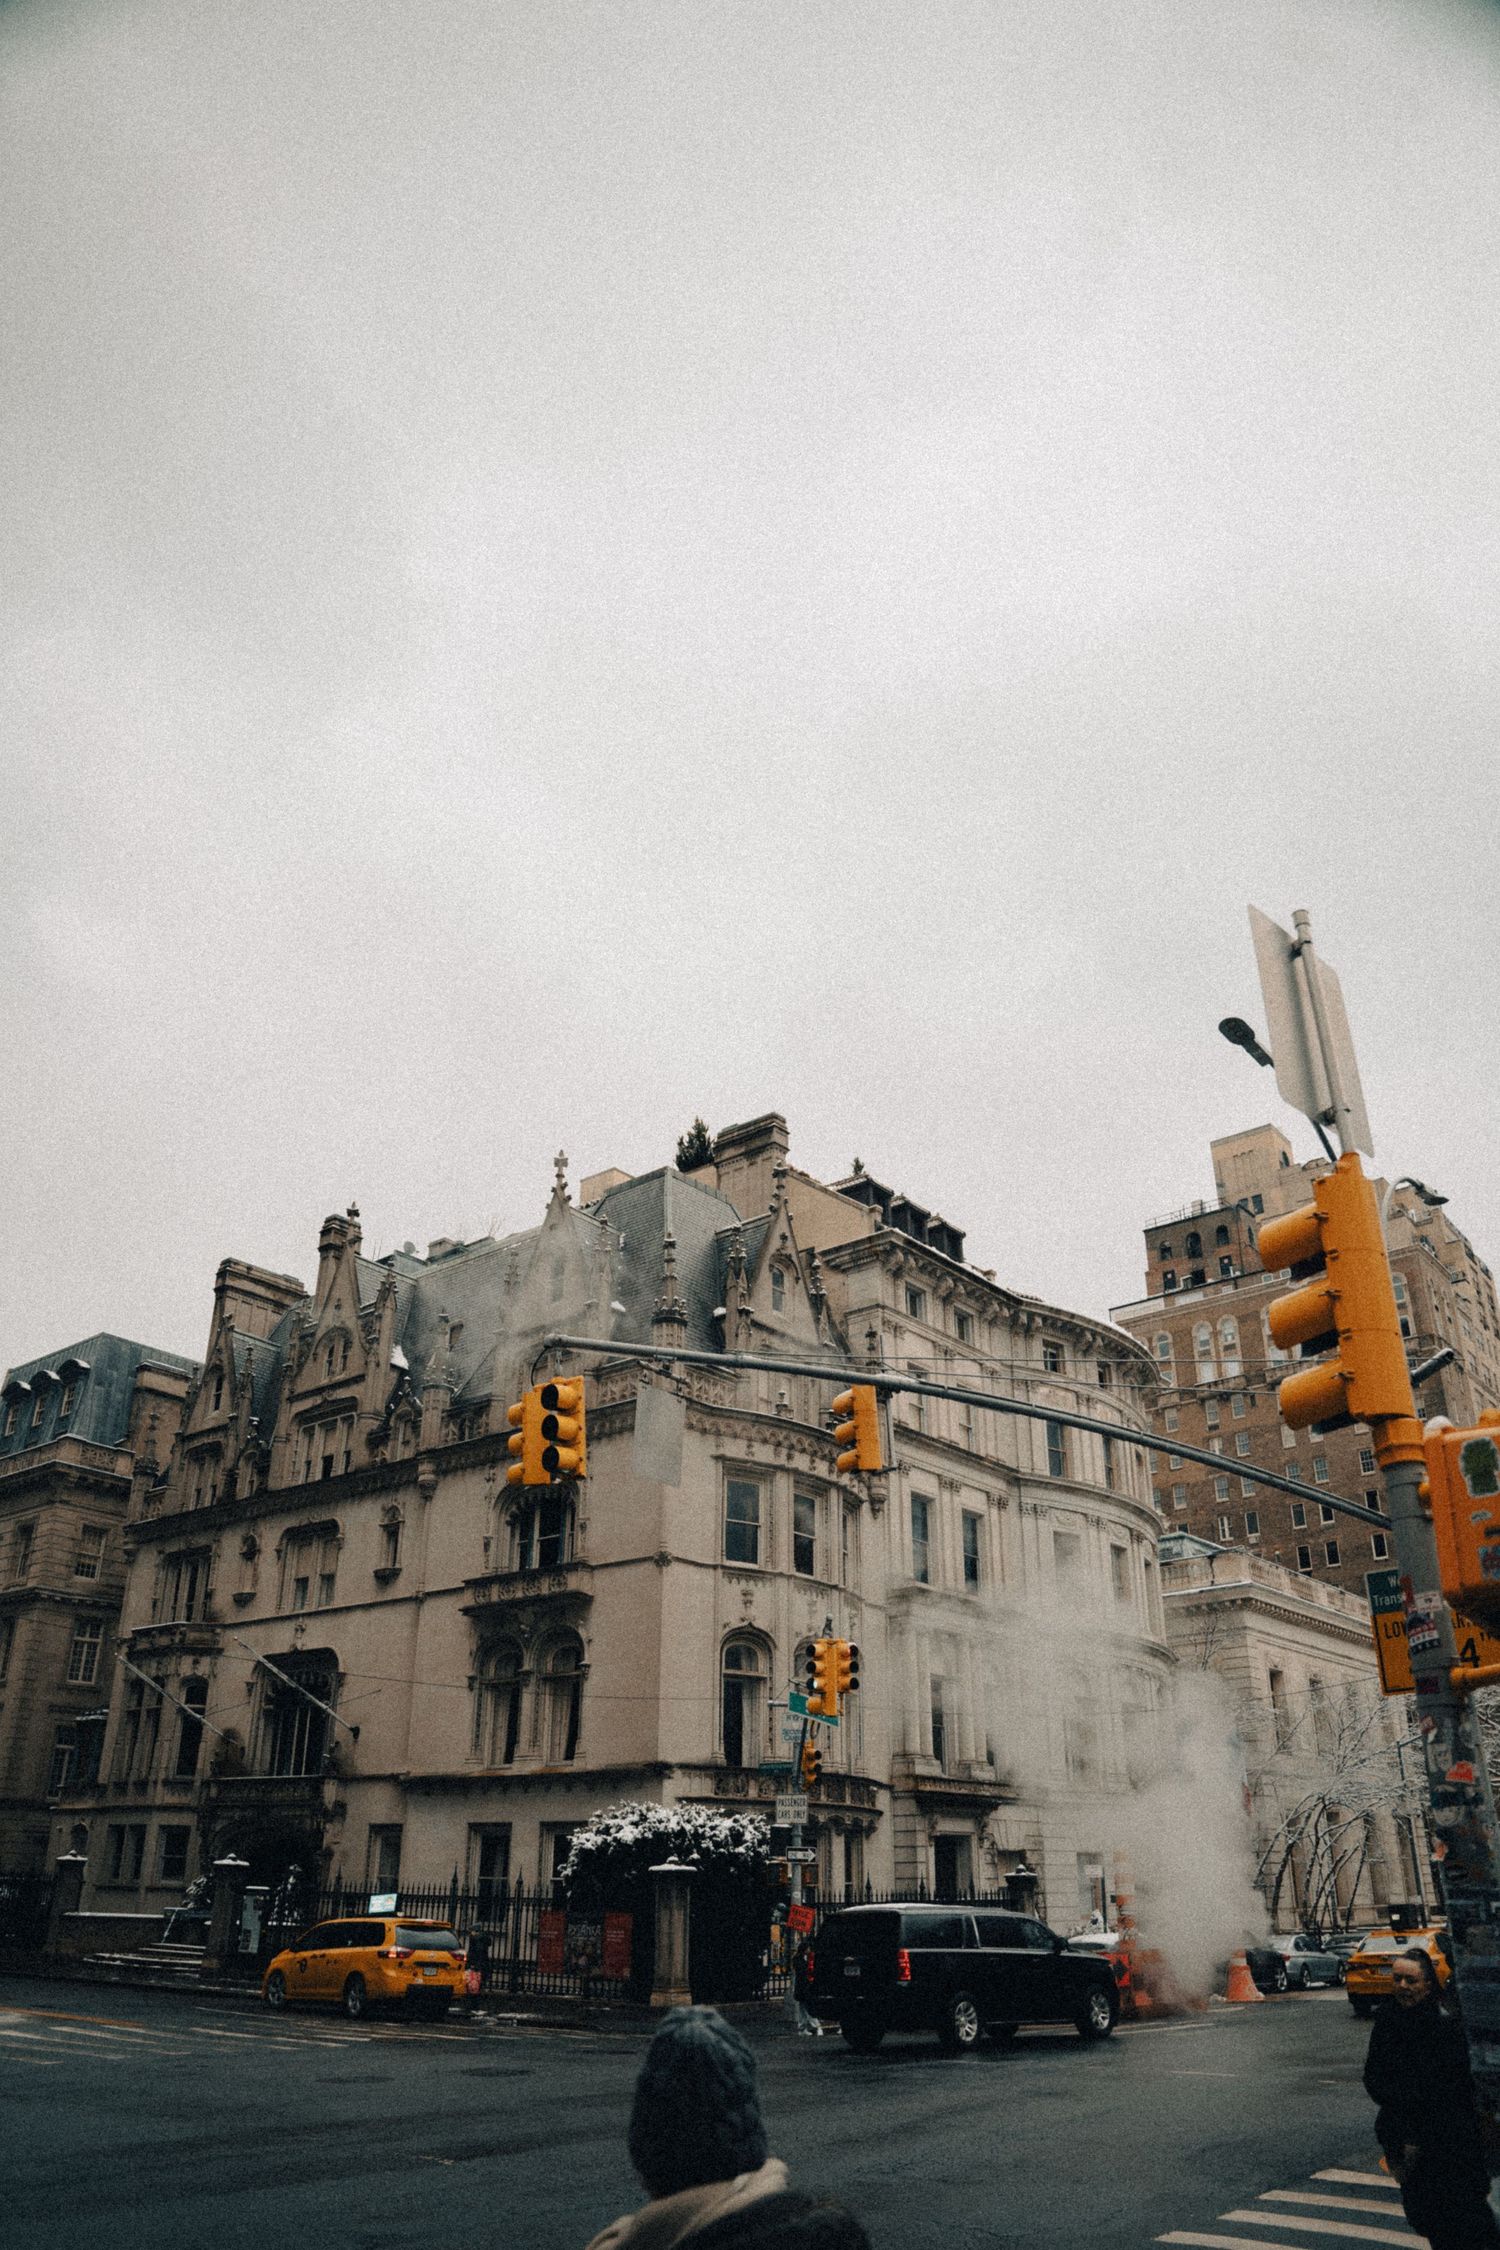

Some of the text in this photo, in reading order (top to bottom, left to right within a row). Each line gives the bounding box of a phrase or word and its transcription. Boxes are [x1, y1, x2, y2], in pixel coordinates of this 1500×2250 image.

[1372, 1594, 1404, 1607] Trans
[778, 1797, 806, 1807] PASSENGER
[778, 1809, 806, 1819] CARS ONLY
